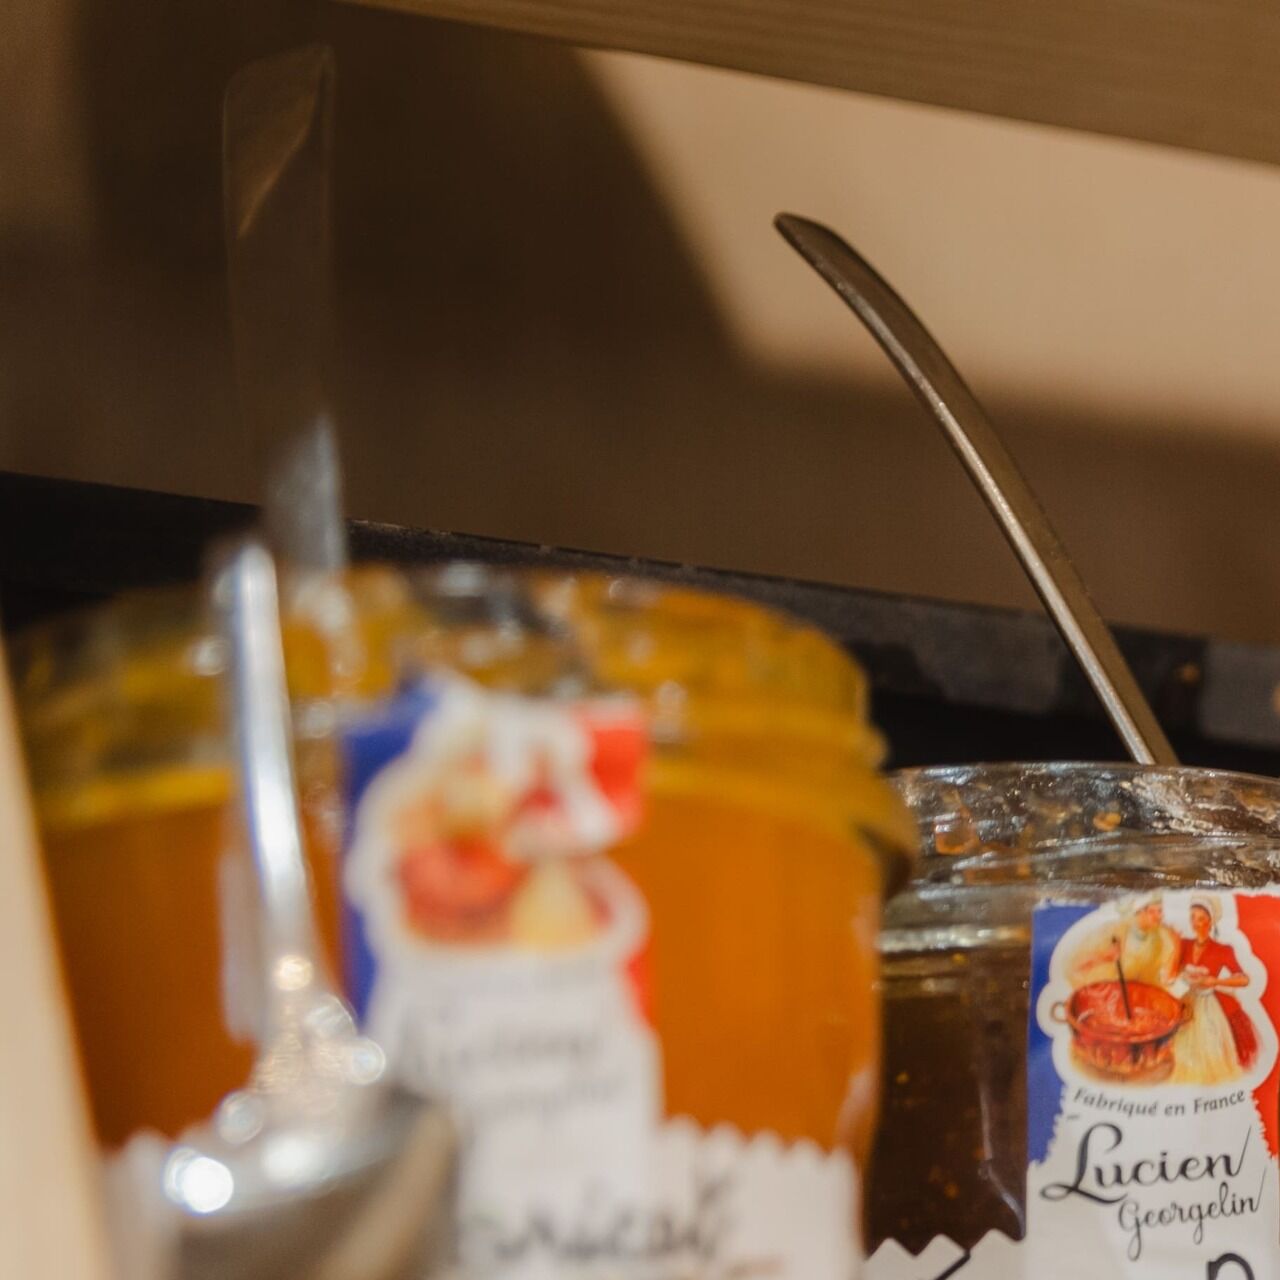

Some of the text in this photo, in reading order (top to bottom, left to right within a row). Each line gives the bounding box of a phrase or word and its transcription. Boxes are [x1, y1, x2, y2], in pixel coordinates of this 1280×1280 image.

[1074, 1087, 1245, 1117] Fabriqué en France
[1039, 1122, 1252, 1205] Lucien
[1118, 1167, 1267, 1262] Georgelin
